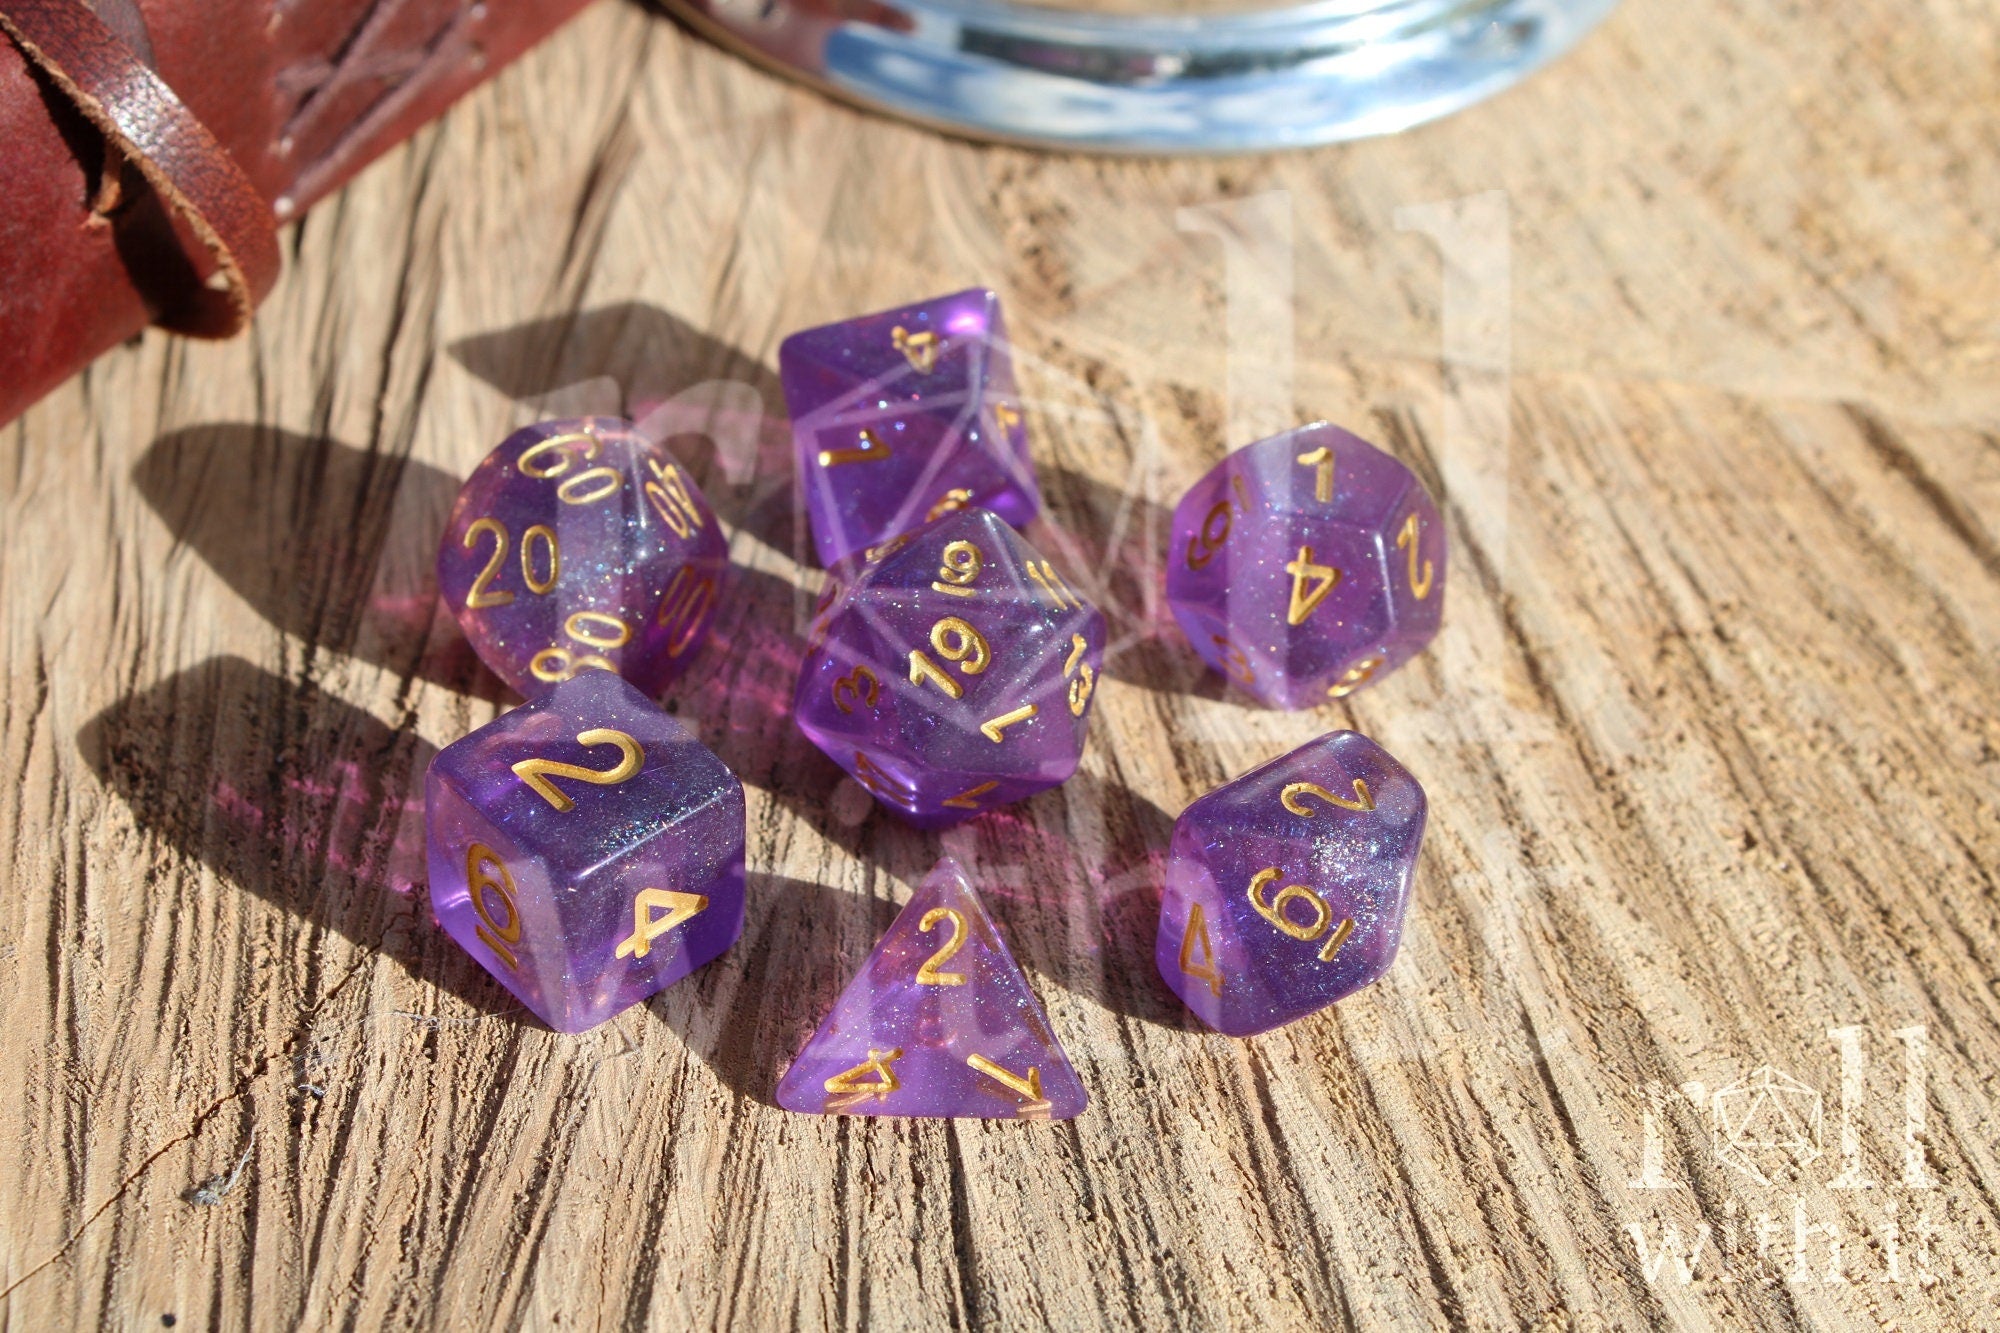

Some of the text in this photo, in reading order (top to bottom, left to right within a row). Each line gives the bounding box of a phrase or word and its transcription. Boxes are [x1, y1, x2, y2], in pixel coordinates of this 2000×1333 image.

[517, 433, 625, 505] 60
[1297, 447, 1335, 502] 1
[464, 517, 561, 609] 20
[1286, 545, 1342, 625] 4
[1396, 513, 1433, 600] 2
[833, 665, 879, 714] 3
[908, 616, 992, 699] 19
[511, 728, 645, 813] 2
[1280, 779, 1376, 818] 2
[615, 888, 709, 960] 4
[915, 907, 970, 986] 2
[1178, 901, 1226, 999] 4
[823, 1047, 904, 1094] 4
[966, 1052, 1043, 1101] 1
